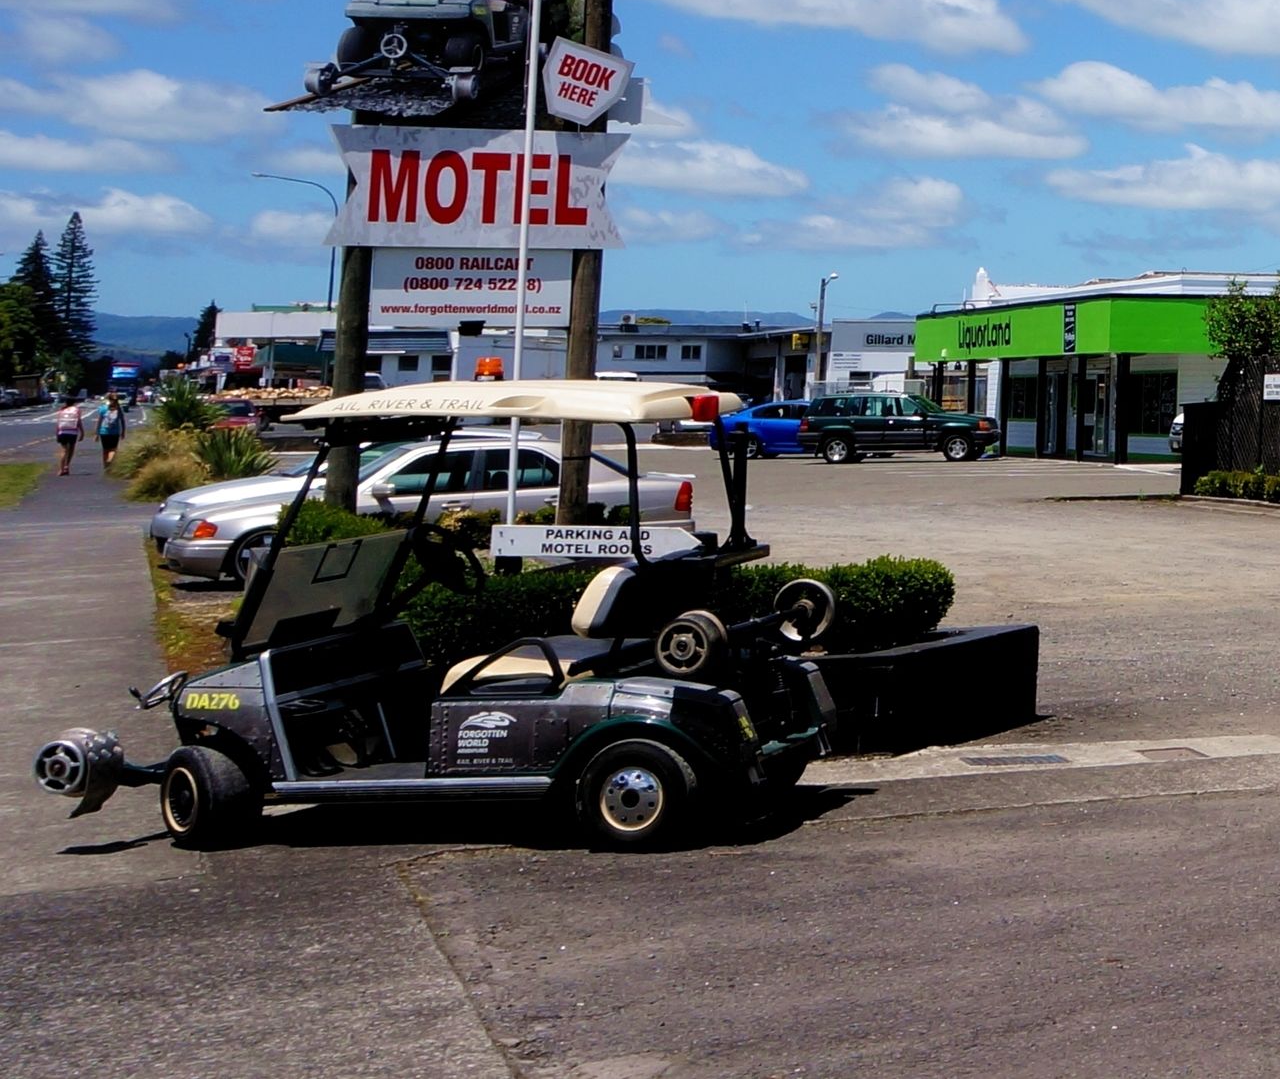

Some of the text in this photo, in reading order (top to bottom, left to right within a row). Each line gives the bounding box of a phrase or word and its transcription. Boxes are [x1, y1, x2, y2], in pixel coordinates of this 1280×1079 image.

[557, 53, 617, 91] BOOK
[557, 81, 599, 108] HERE
[367, 149, 588, 226] MOTEL
[415, 257, 455, 271] 0800
[403, 276, 542, 293] (0800 724 5228)
[866, 334, 904, 345] Gillard
[368, 399, 419, 410] RIVER
[420, 399, 433, 410] &
[439, 398, 484, 410] TRAIL
[545, 529, 651, 541] PARKING AD
[541, 543, 653, 555] MOTEL ROOS
[185, 692, 240, 710] DA276
[458, 730, 508, 739] FORGOTTEN
[457, 739, 489, 747] WORLD
